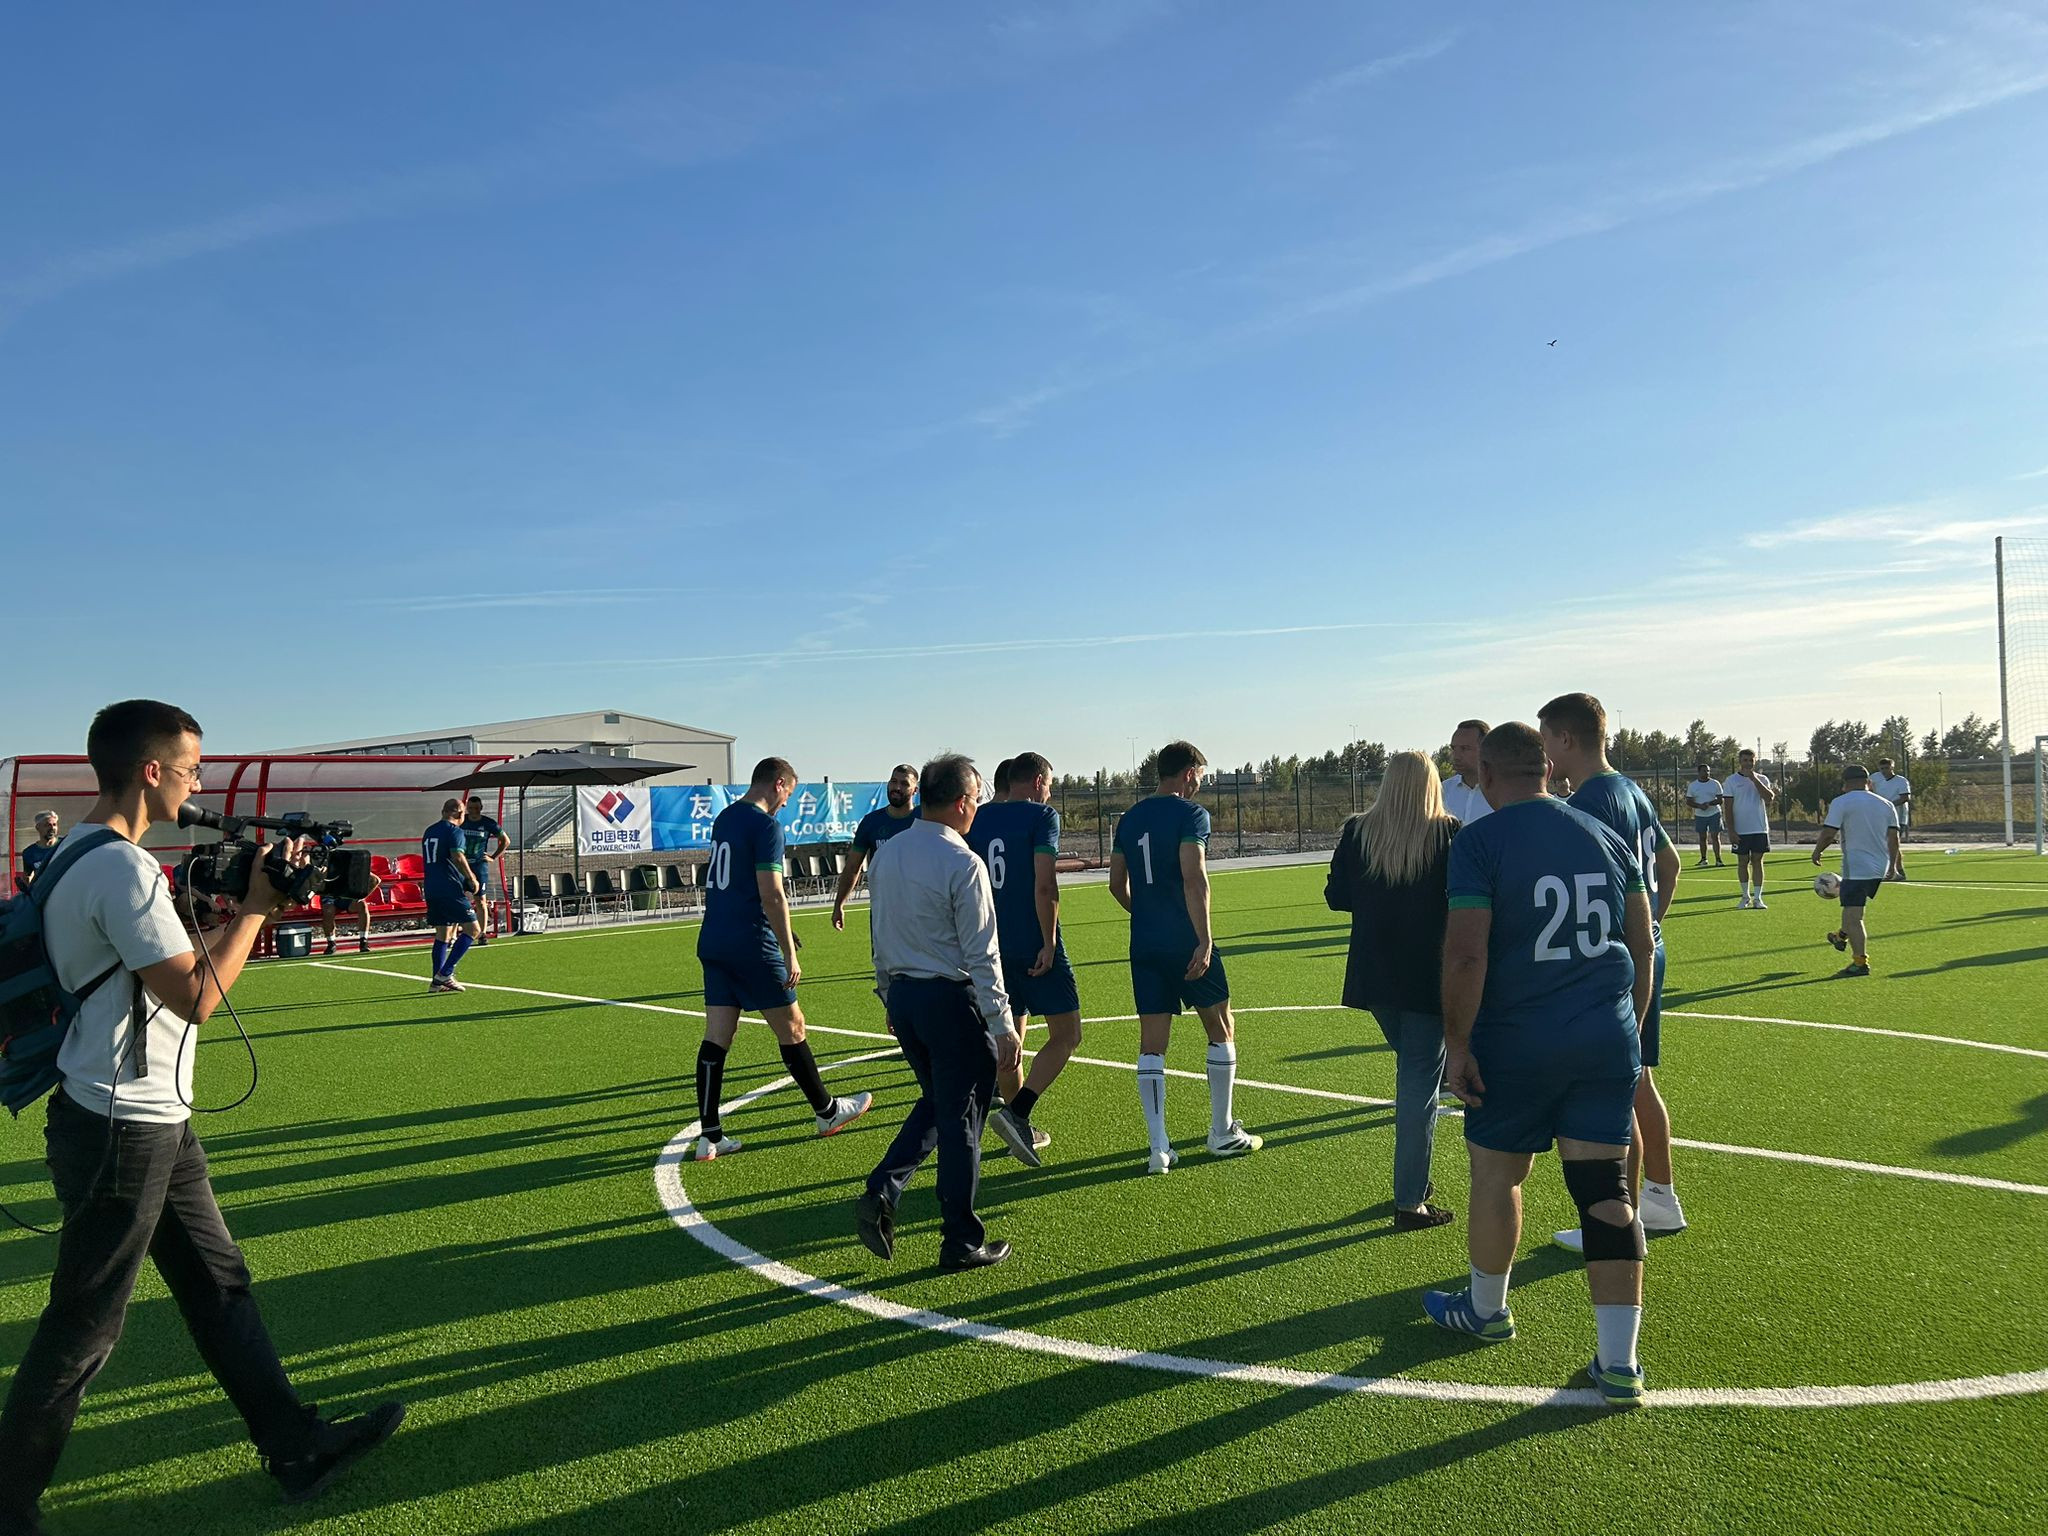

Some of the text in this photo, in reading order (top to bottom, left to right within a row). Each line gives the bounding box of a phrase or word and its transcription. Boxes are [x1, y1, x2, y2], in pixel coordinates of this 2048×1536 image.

[424, 838, 439, 863] 17
[592, 829, 641, 843] 中国电建
[592, 843, 641, 851] POWERCHINA
[1138, 832, 1153, 884] 1
[706, 840, 731, 890] 20
[988, 837, 1006, 889] 6
[1534, 872, 1611, 962] 25
